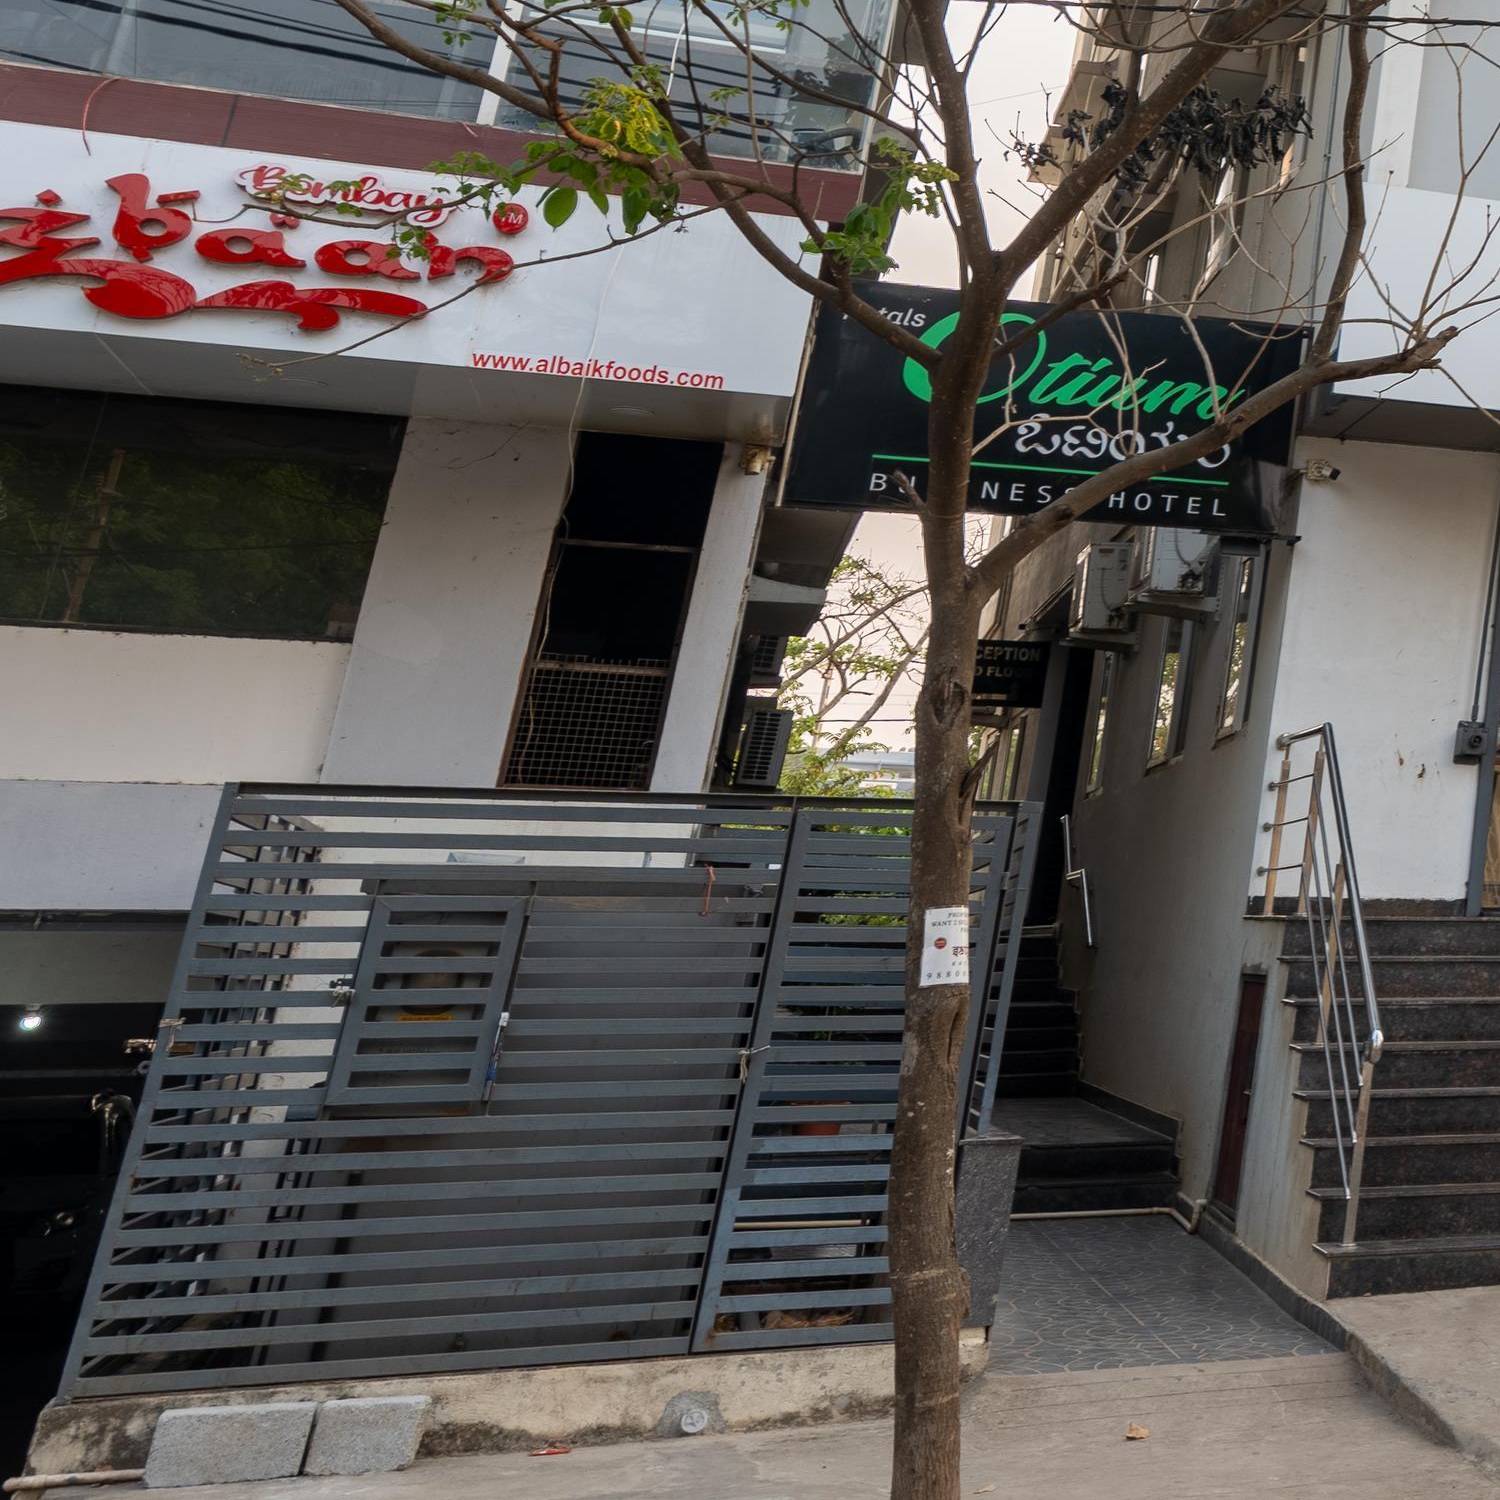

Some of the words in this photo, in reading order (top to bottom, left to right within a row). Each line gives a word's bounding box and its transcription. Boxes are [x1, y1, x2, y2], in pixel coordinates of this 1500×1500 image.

[472, 352, 724, 390] www.albaikfoods.com
[903, 310, 1246, 420] Otium
[1109, 491, 1228, 517] HOTEL
[976, 645, 1041, 661] CEPTION
